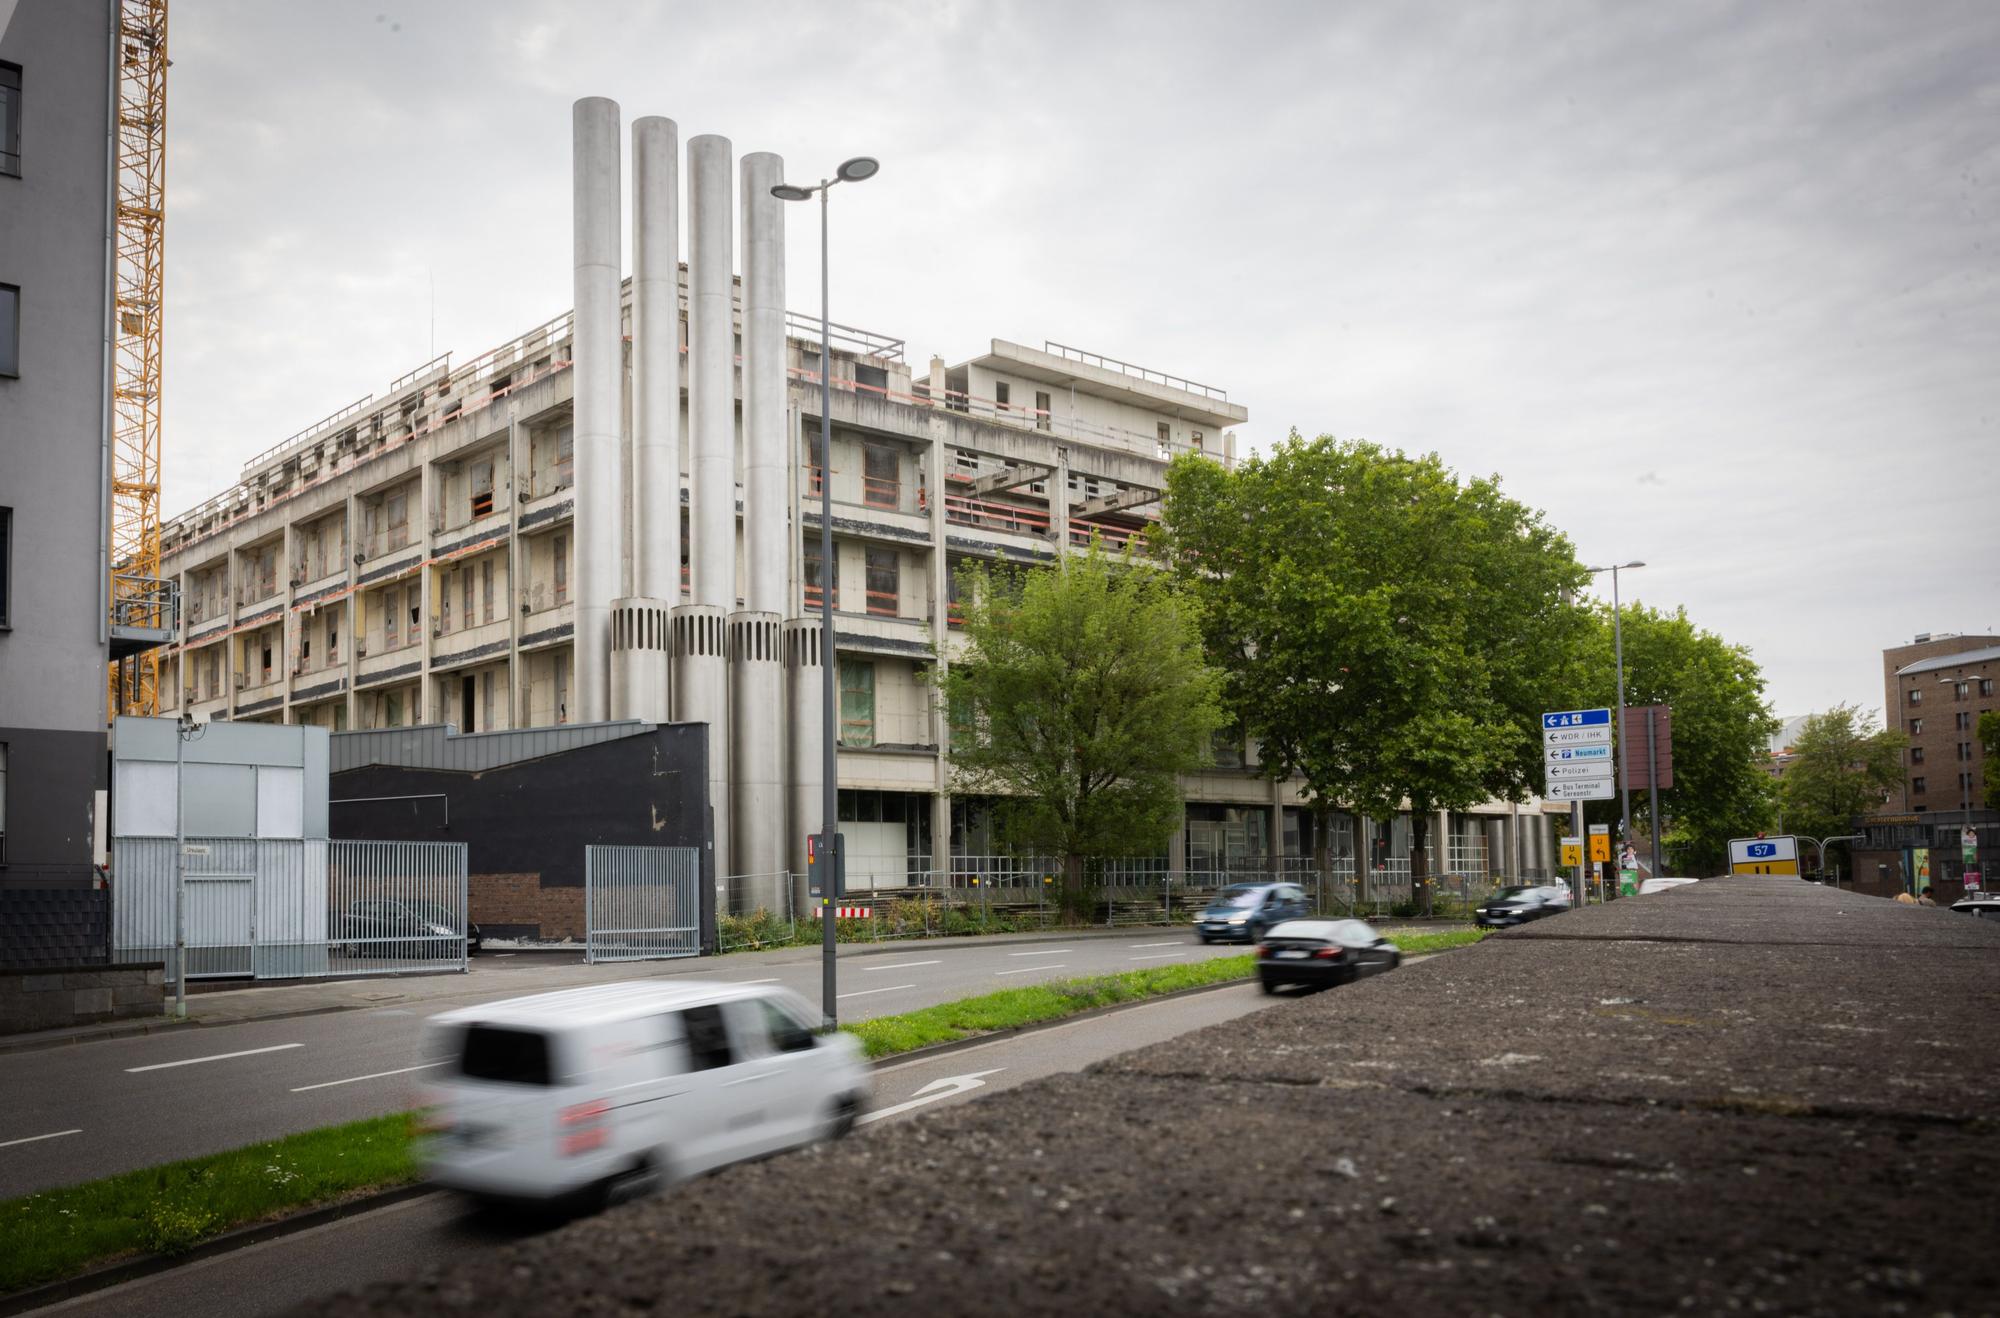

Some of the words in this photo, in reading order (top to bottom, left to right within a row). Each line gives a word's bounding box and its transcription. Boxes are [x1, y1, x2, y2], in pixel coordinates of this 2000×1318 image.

[1587, 731, 1602, 739] IHK
[1575, 749, 1606, 757] Neumarkt
[1754, 845, 1768, 856] 57
